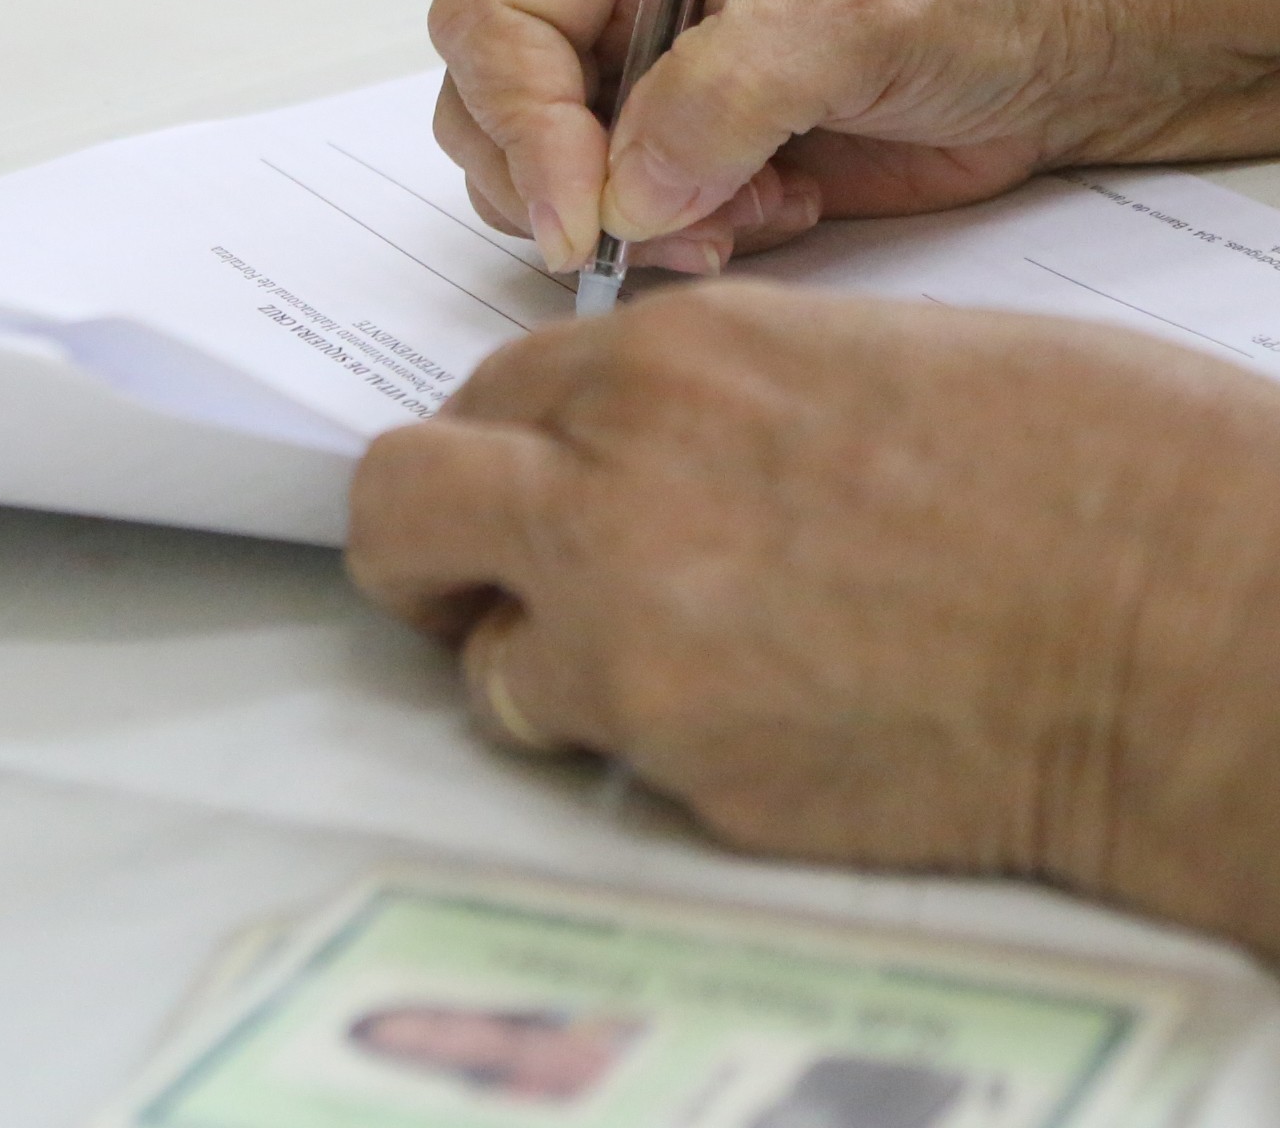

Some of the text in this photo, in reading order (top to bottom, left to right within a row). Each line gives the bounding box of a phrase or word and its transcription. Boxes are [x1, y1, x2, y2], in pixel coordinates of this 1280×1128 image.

[1132, 204, 1151, 213] de
[1149, 211, 1189, 230] Bairro
[1192, 231, 1222, 243] 304
[210, 246, 263, 280] Fortaleza
[257, 278, 276, 288] de
[257, 304, 297, 326] CRUZ
[266, 288, 341, 332] Habitacional
[290, 324, 354, 363] SIQUEIRA
[352, 321, 456, 382] INTERVENIENTE
[337, 330, 434, 393] Desenvolvimento
[343, 362, 371, 376] DE
[364, 374, 408, 401] VITAL
